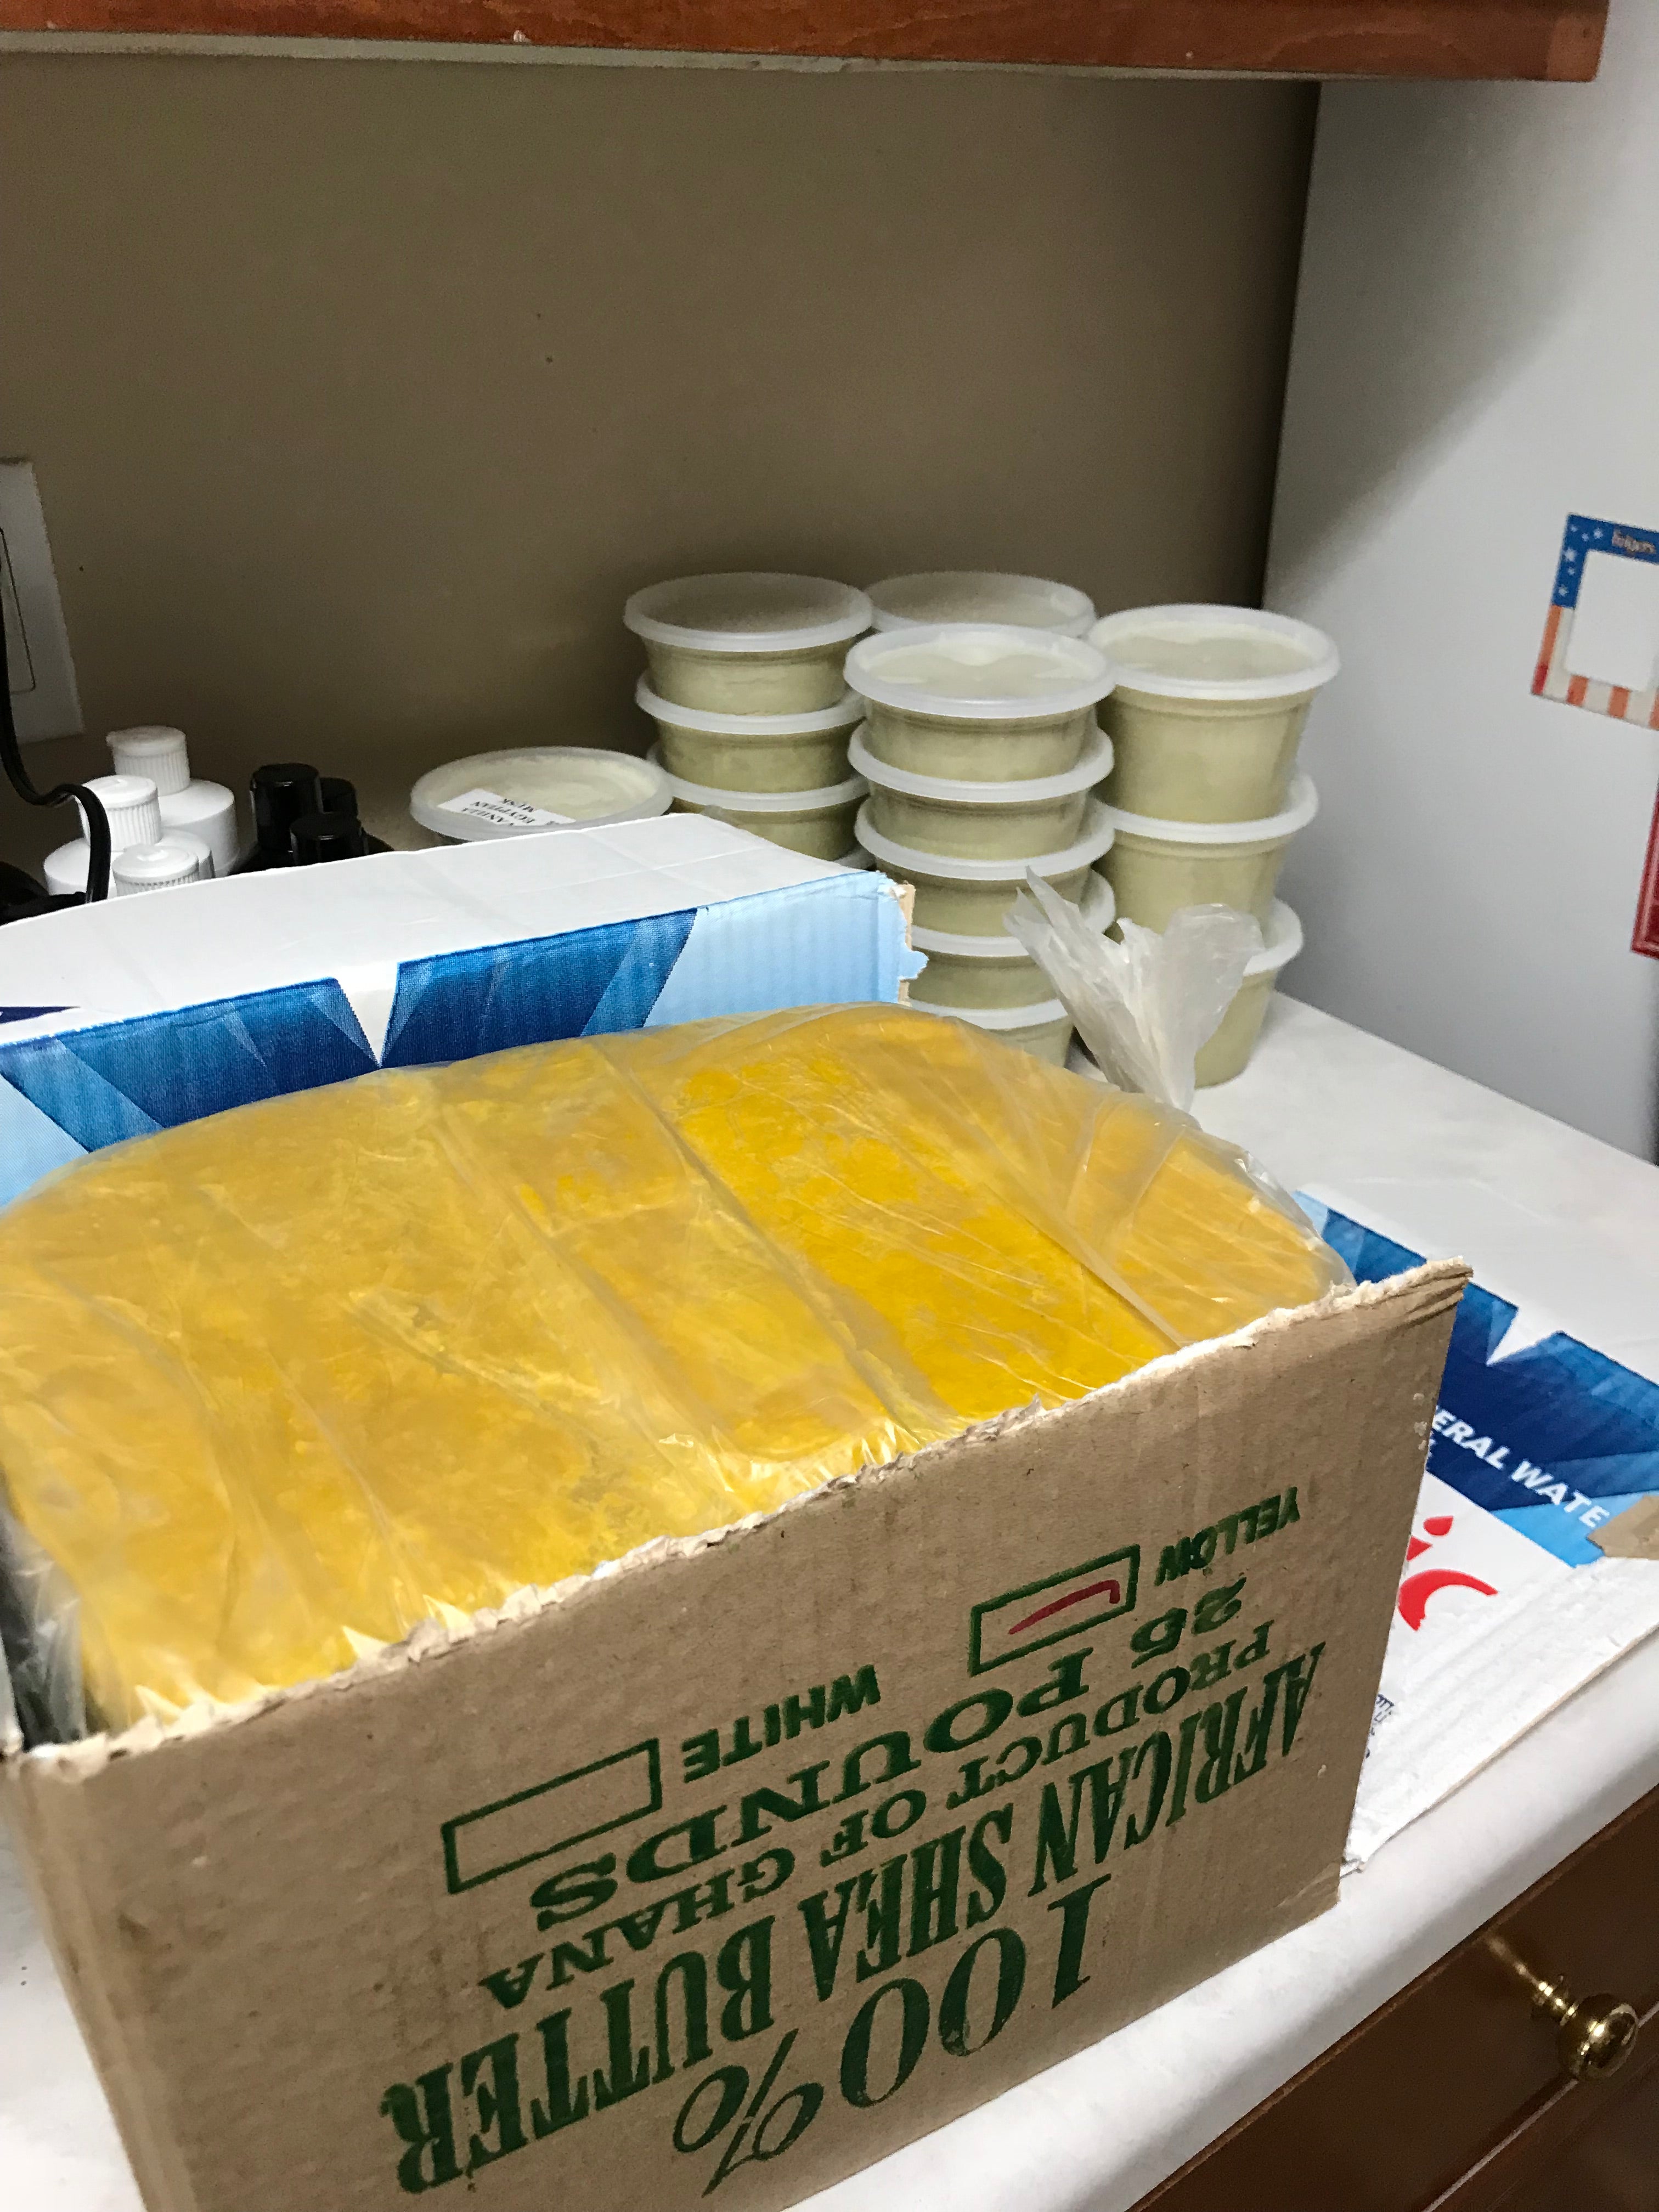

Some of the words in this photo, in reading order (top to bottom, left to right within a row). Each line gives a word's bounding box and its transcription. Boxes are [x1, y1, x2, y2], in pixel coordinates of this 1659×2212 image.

[462, 808, 514, 826] ANILLA
[1432, 1405, 1511, 1471] ERAL
[1154, 1486, 1301, 1587] YELLOW
[1131, 1576, 1246, 1668] 25
[530, 1648, 1093, 1931] POUNDS
[682, 1664, 881, 1782] WHITE
[947, 1619, 1274, 1808] PRODUCT
[1030, 1641, 1326, 1896] AFRICAN
[798, 1804, 1013, 2001] SHEA
[820, 1790, 927, 1867] OF
[479, 1848, 794, 2009] GHANA
[380, 1916, 775, 2193] BUTTER
[674, 1875, 1109, 2198] 100%
